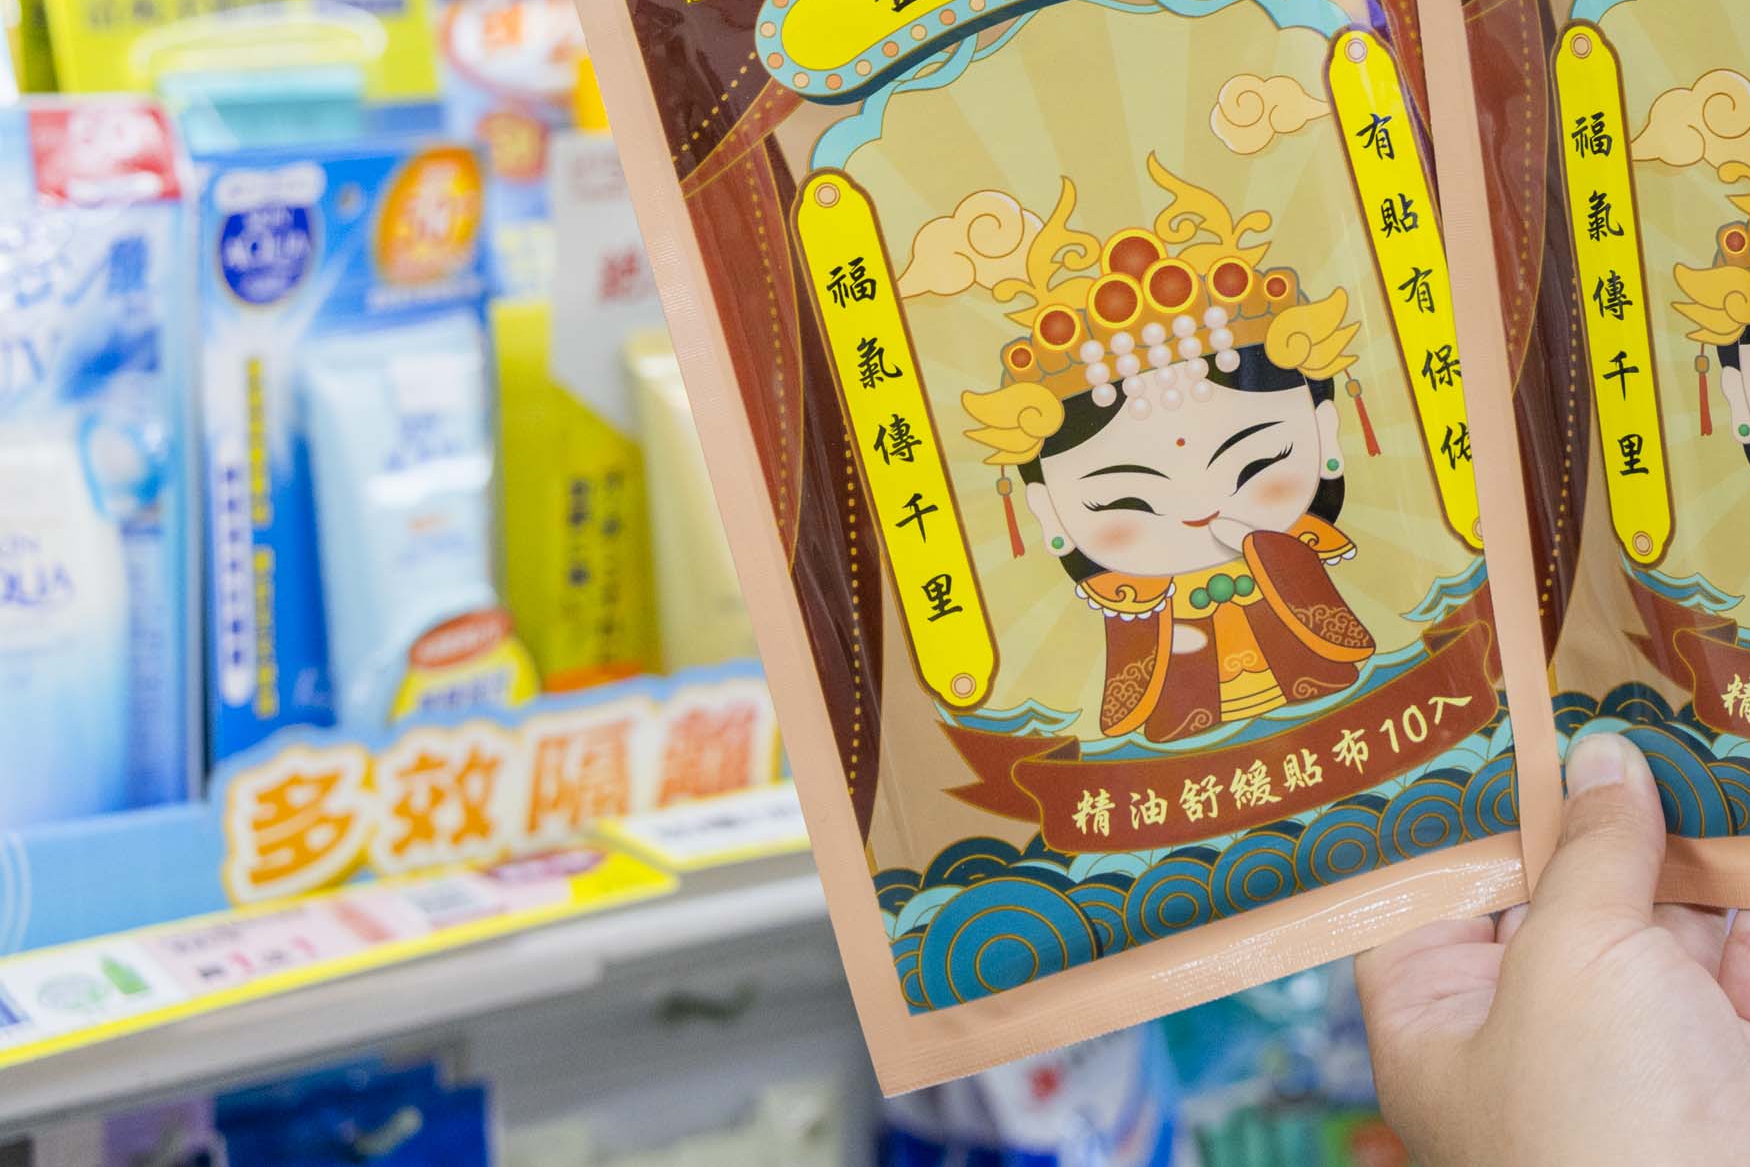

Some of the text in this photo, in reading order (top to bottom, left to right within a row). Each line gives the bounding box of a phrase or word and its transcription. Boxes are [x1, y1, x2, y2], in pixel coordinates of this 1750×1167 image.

[1571, 111, 1651, 477] 福氣傳千里
[827, 256, 963, 622] 福氣傳千里
[250, 702, 757, 887] 多效隔離
[1072, 692, 1473, 838] 精油舒緩貼布10入
